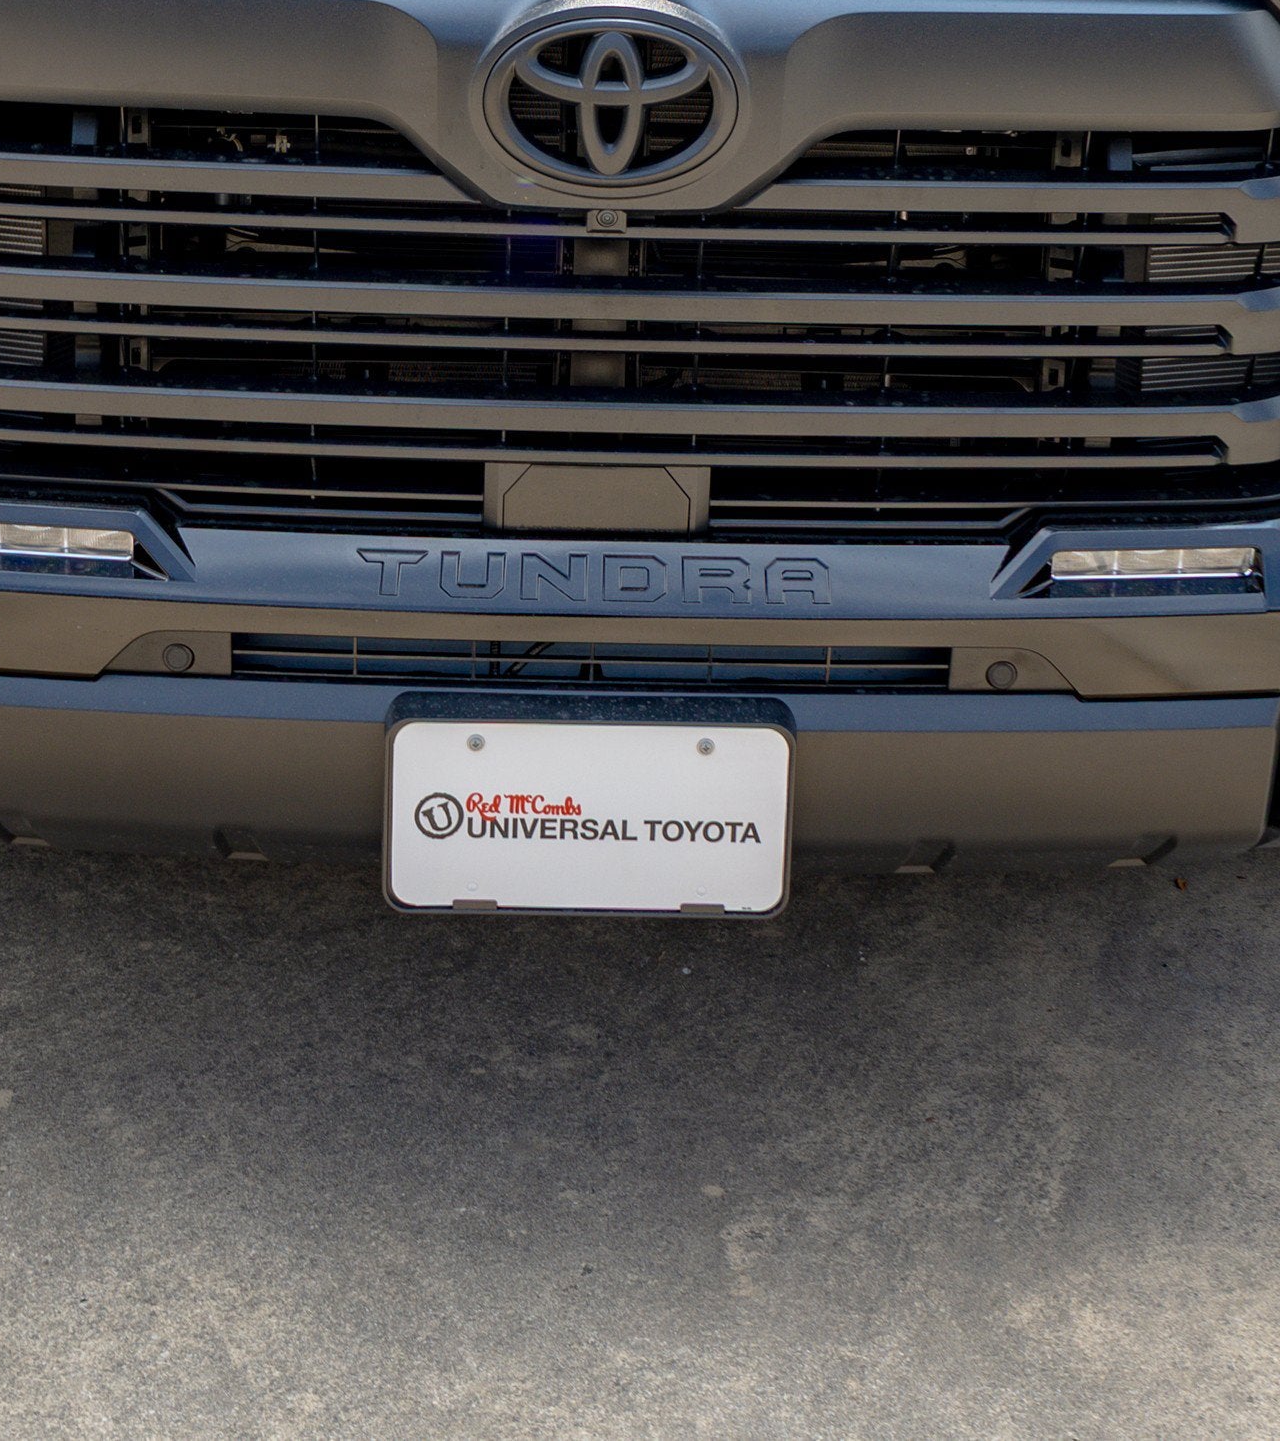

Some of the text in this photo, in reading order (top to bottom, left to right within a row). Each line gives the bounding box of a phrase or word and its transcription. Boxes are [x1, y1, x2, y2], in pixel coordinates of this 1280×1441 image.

[356, 547, 832, 605] TUNDRA
[466, 792, 501, 821] Red
[467, 816, 762, 844] UNIVERSAL TOYOTA
